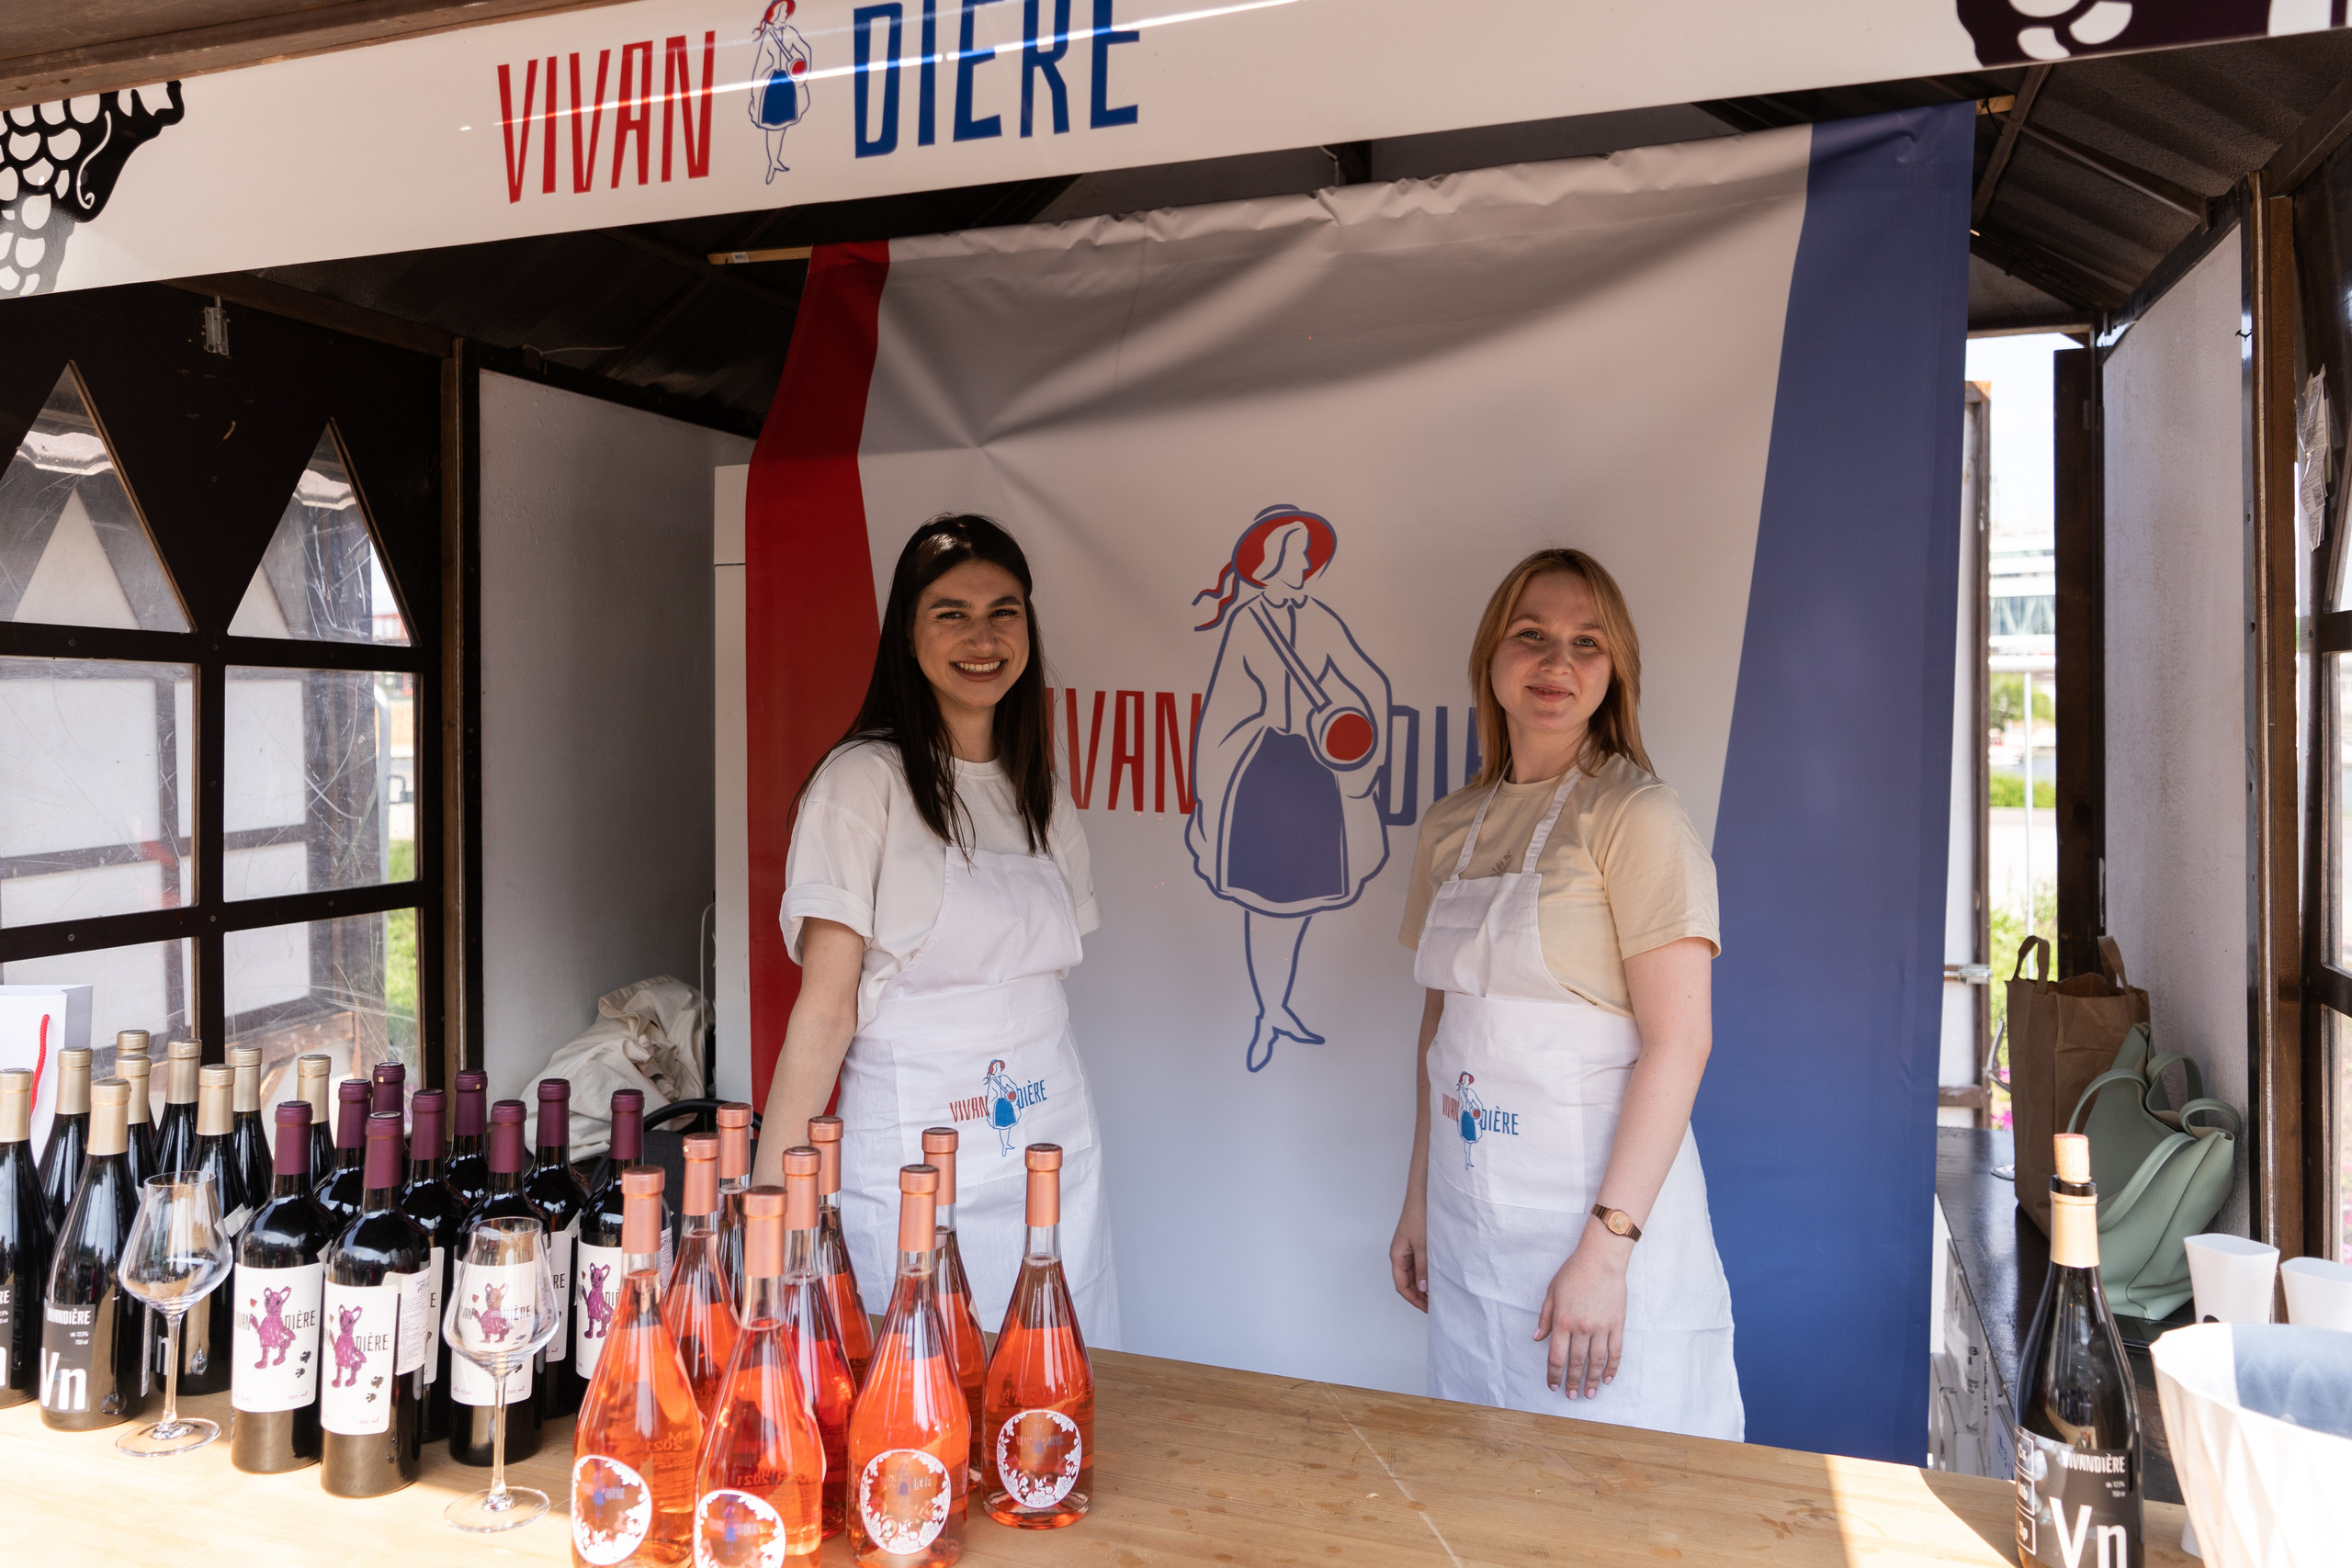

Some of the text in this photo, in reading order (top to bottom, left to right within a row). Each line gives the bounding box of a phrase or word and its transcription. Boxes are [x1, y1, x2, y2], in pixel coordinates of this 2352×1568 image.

[497, 30, 716, 204] VIVAN
[949, 1079, 1047, 1122] VIVAN DIÈRE
[1481, 1106, 1519, 1135] DIÈRE
[284, 1309, 316, 1331] DIÈRE
[356, 1332, 390, 1352] DIÈRE
[40, 1348, 87, 1411] Vn
[2061, 1450, 2126, 1473] VIVANDIÈRE
[2049, 1496, 2128, 1568] Vn
